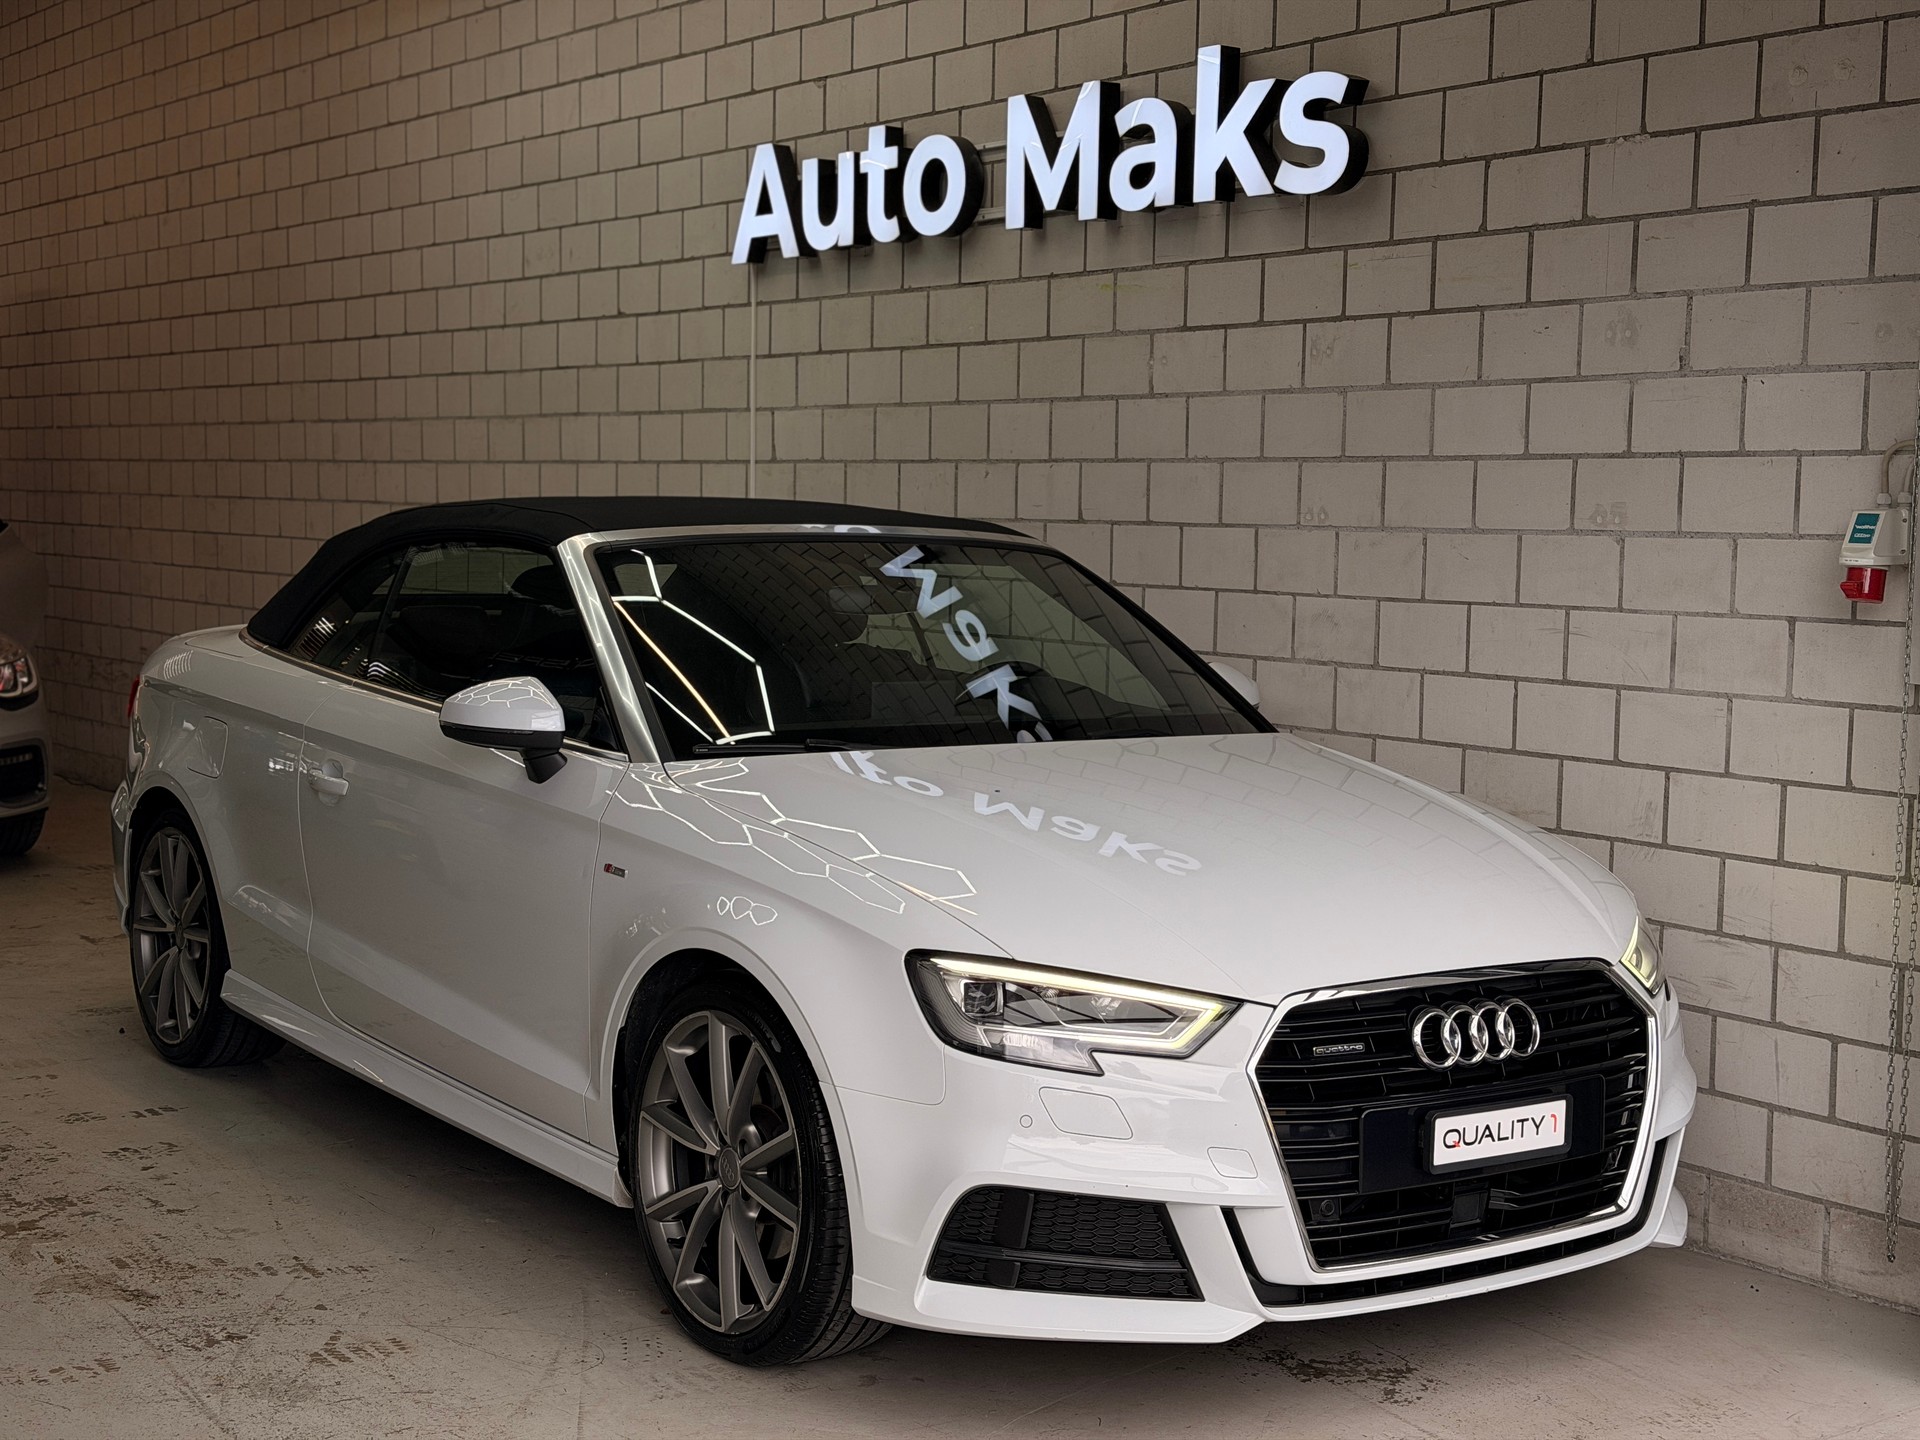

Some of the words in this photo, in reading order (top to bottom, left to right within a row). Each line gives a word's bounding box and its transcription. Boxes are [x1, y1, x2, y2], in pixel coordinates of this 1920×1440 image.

[731, 125, 977, 265] Auto
[1004, 44, 1366, 230] Maks
[1316, 1044, 1363, 1056] quattro
[1443, 1115, 1546, 1149] QUALITY
[1550, 1113, 1558, 1133] 1
